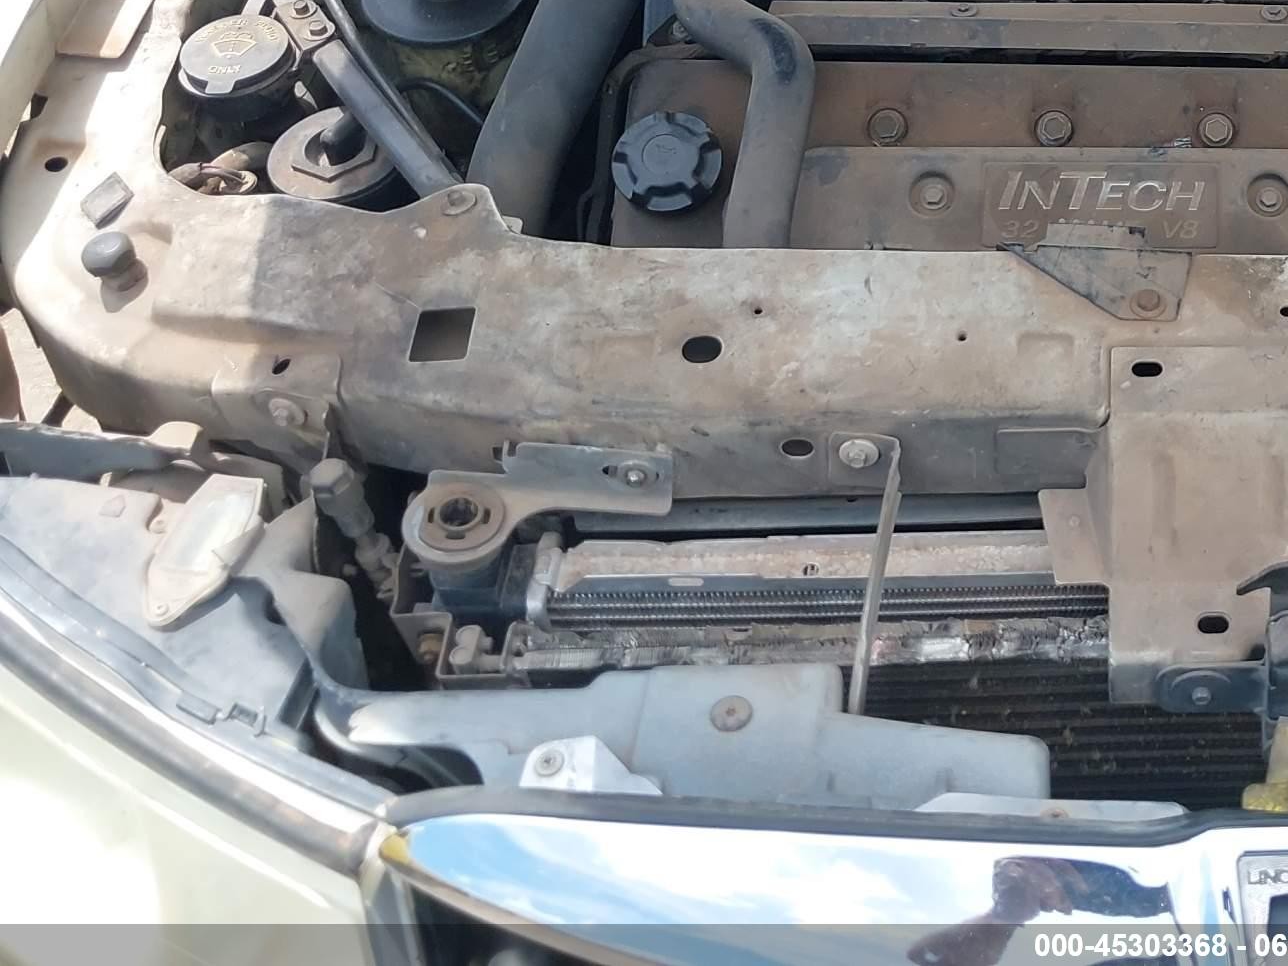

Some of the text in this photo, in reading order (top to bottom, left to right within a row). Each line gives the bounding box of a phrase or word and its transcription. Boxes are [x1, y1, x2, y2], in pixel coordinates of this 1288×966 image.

[208, 65, 241, 74] ONLY
[1001, 219, 1040, 239] 32
[1162, 219, 1200, 239] V8
